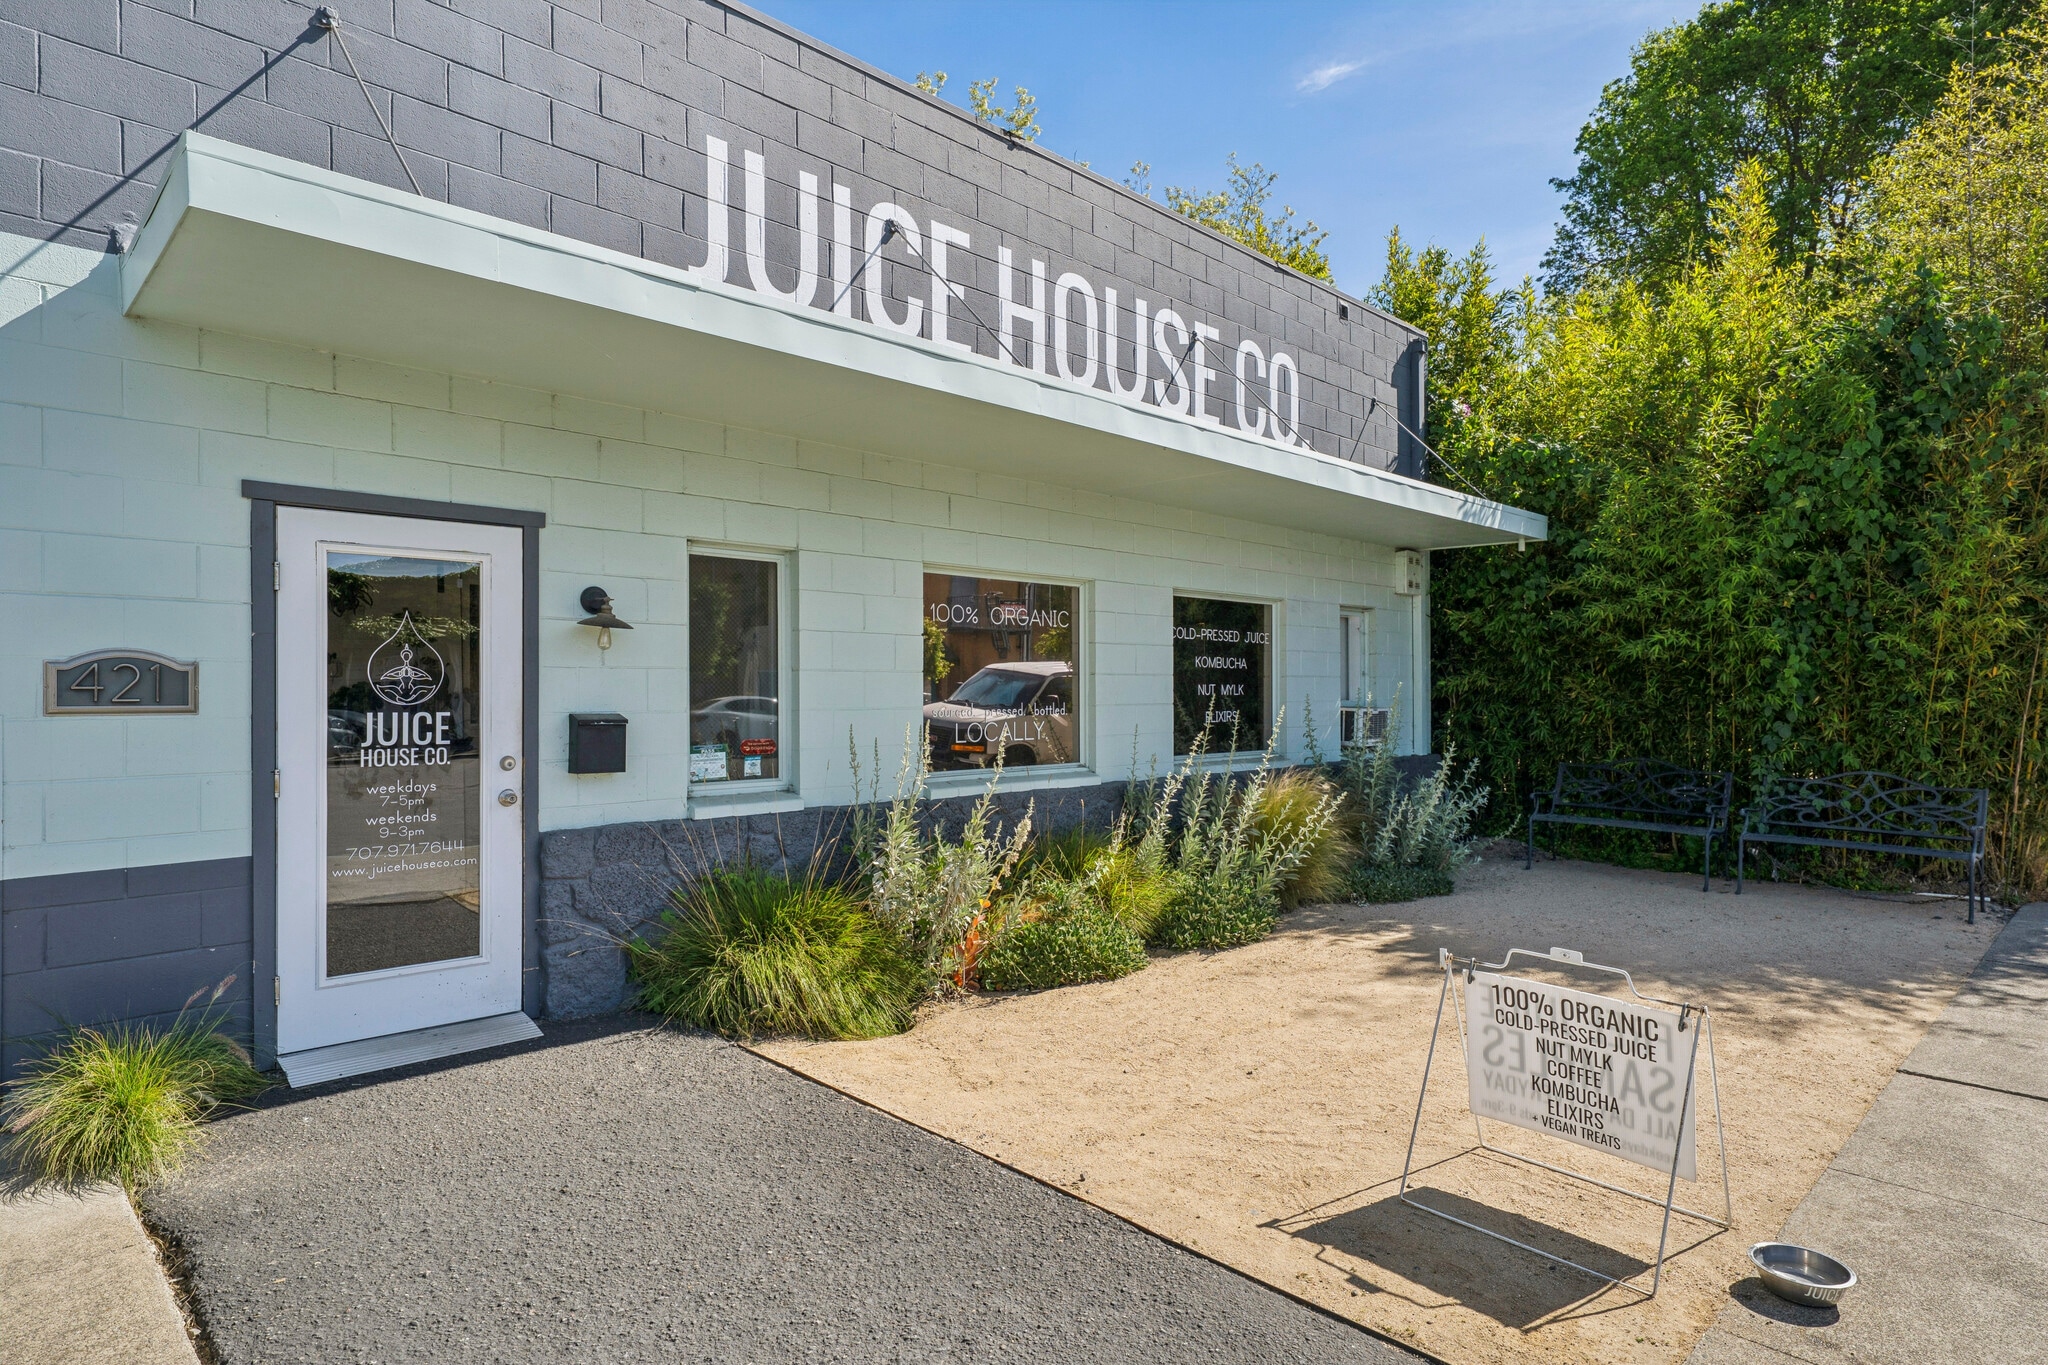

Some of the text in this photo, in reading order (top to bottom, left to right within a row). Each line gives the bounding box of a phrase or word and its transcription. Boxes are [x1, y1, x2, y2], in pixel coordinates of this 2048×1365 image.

[688, 134, 971, 353] JUICE
[998, 245, 1220, 425] HOUSE
[930, 602, 1070, 628] 100% ORGANIC
[1172, 626, 1270, 644] COLD-PRESSED JUICE
[1195, 656, 1247, 669] KOMBUCHA
[70, 662, 160, 703] 421
[1197, 684, 1244, 695] NUT MYLK
[985, 702, 1026, 722] pressed.
[1034, 702, 1068, 716] bottled.
[1205, 710, 1238, 723] ELIXIRS
[361, 711, 450, 747] JUICE
[955, 720, 1045, 744] LOCALLY
[360, 747, 450, 767] HOUSE CO.
[366, 779, 437, 797] weekdays
[380, 795, 424, 810] 7-5pm
[365, 809, 437, 826] weekends
[379, 827, 424, 839] 9-3pm
[345, 840, 464, 861] 707.971.7644
[331, 856, 477, 879] www.juicehouseco.com
[1492, 984, 1553, 1016] 100%
[1560, 998, 1659, 1042] ORGANIC
[1495, 1008, 1607, 1049] COLD-PRESSED
[1613, 1036, 1657, 1063] JUICE
[1536, 1037, 1613, 1072] NUT MYLK
[1547, 1060, 1601, 1089] COFFEE
[1531, 1074, 1620, 1115] KOMBUCHA
[1548, 1099, 1604, 1130] ELIXIRS
[1541, 1115, 1577, 1137] VEGAN
[1580, 1126, 1621, 1150] TREATS
